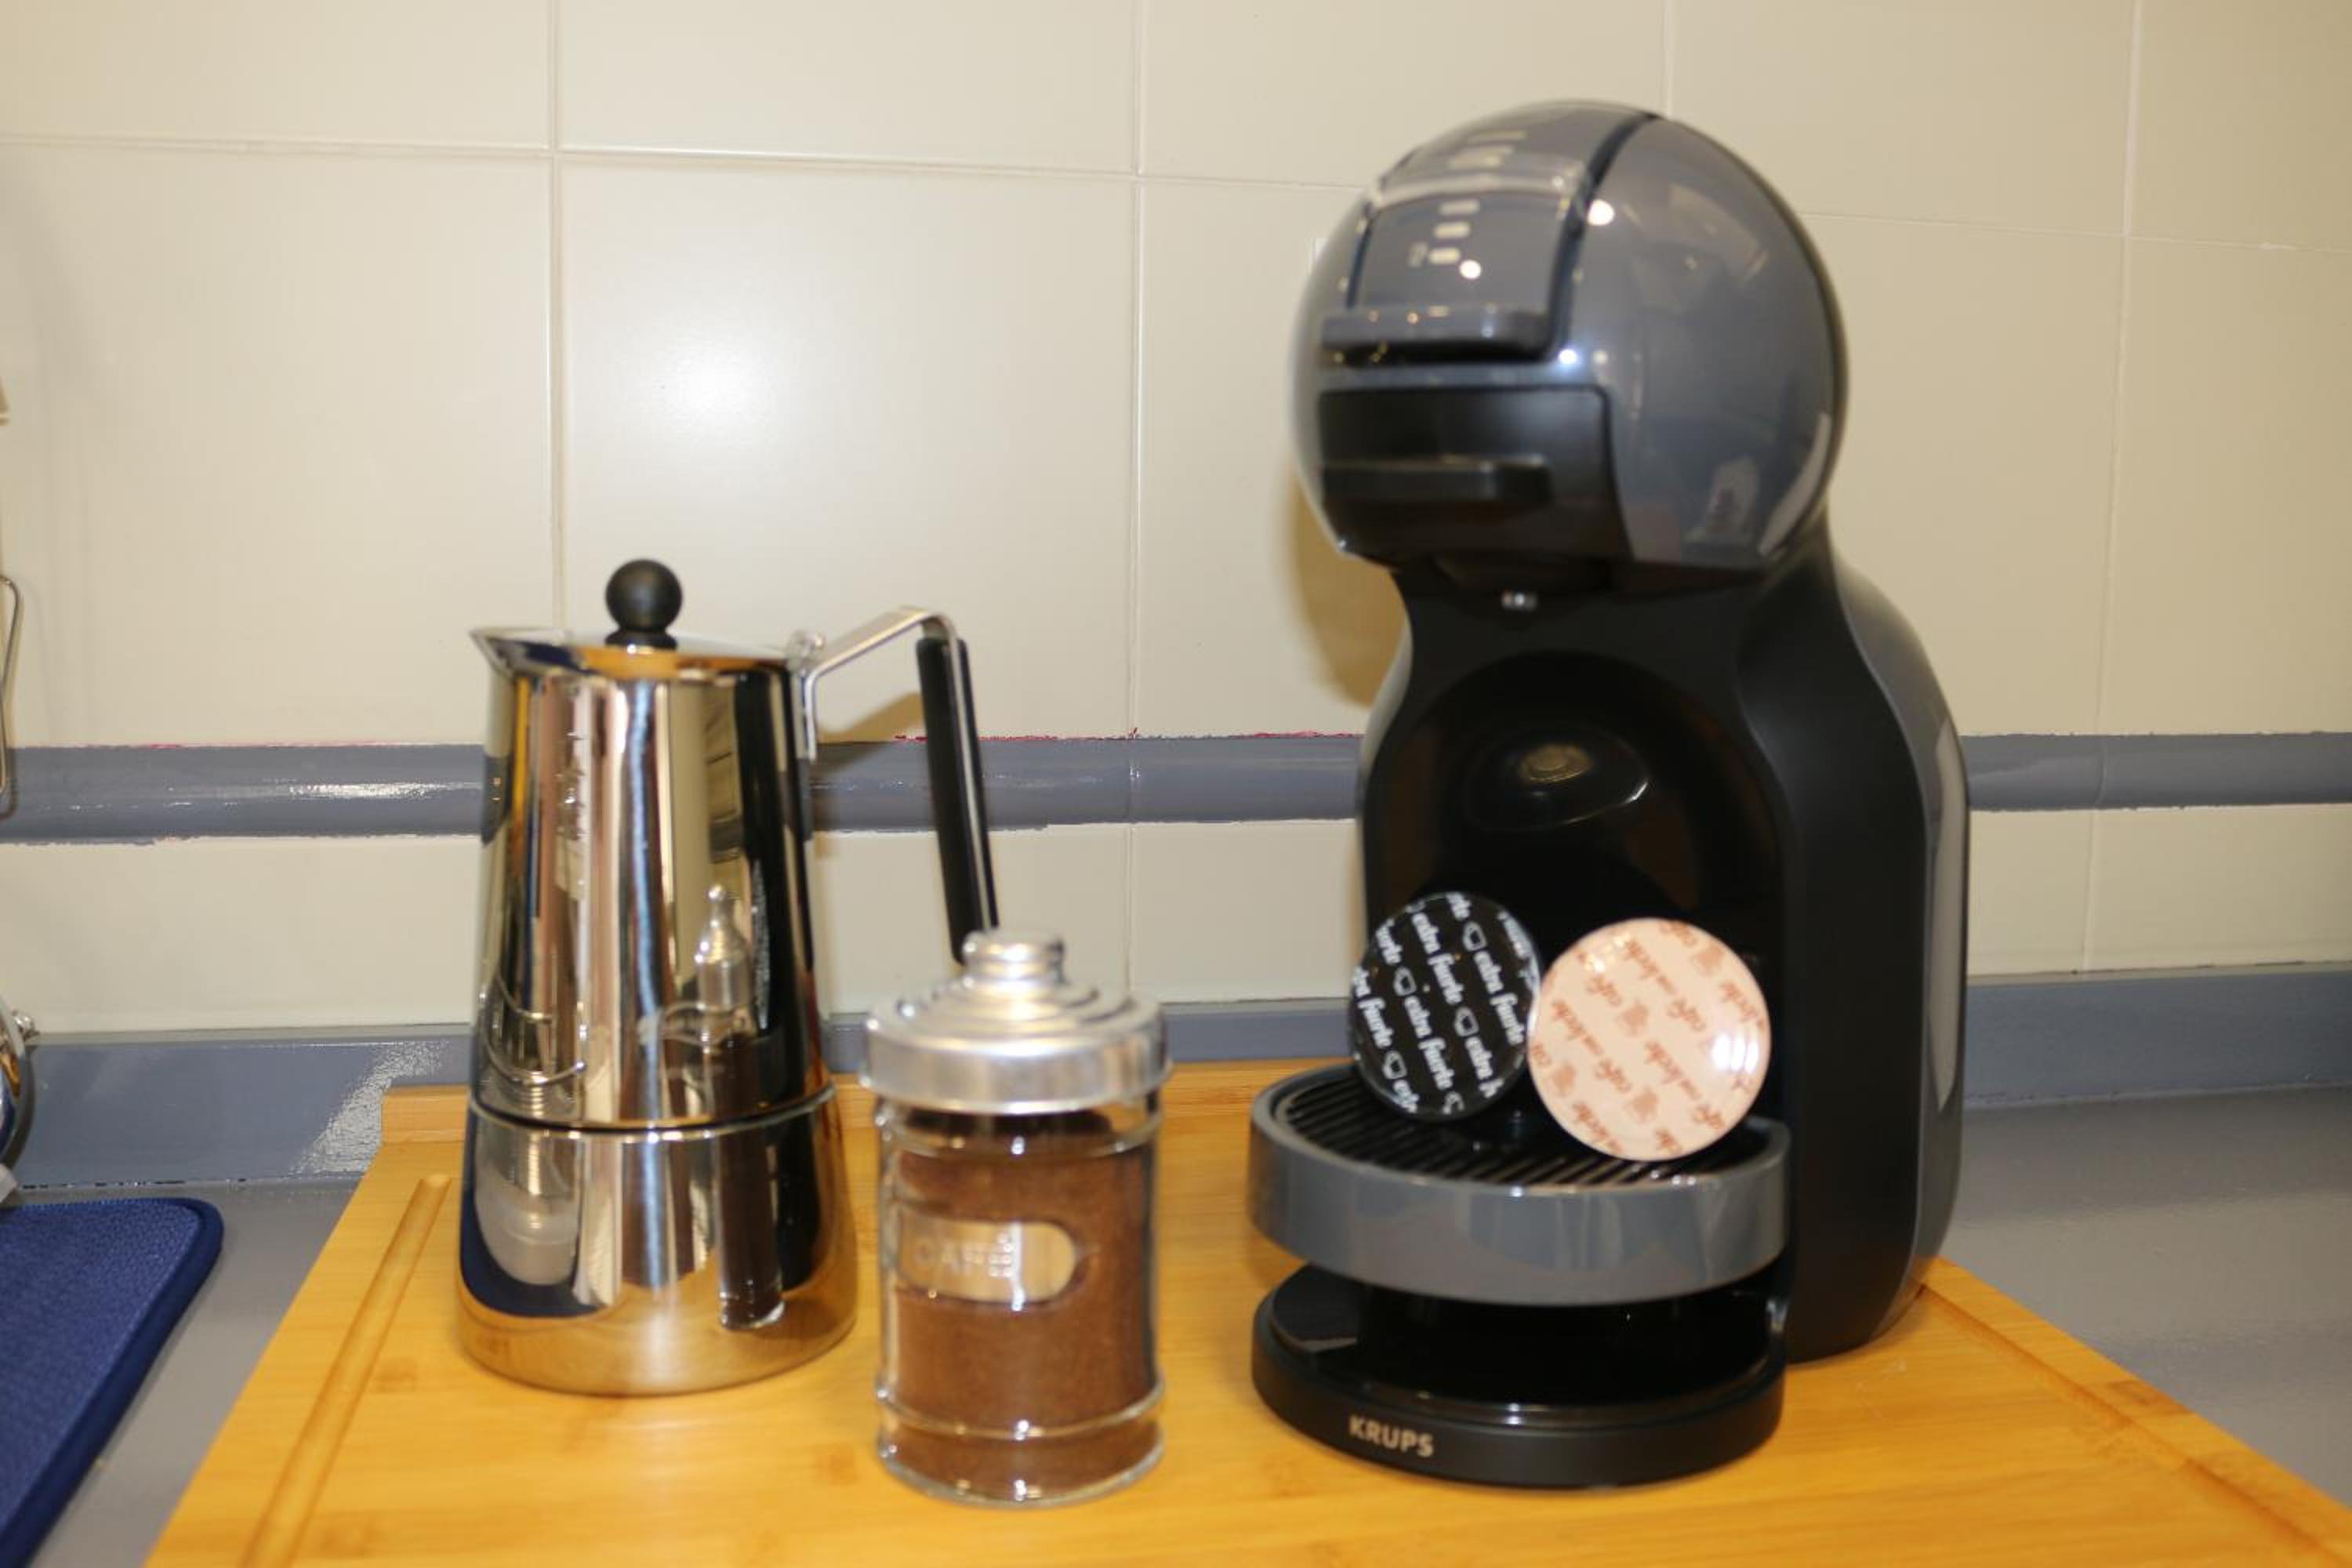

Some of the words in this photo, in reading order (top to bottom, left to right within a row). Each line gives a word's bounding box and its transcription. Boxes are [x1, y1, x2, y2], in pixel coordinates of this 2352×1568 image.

[1428, 953, 1464, 1004] fuerte
[1358, 997, 1393, 1049] fuerte
[1418, 1037, 1454, 1090] fuerte
[1350, 1415, 1433, 1457] KRUPS
